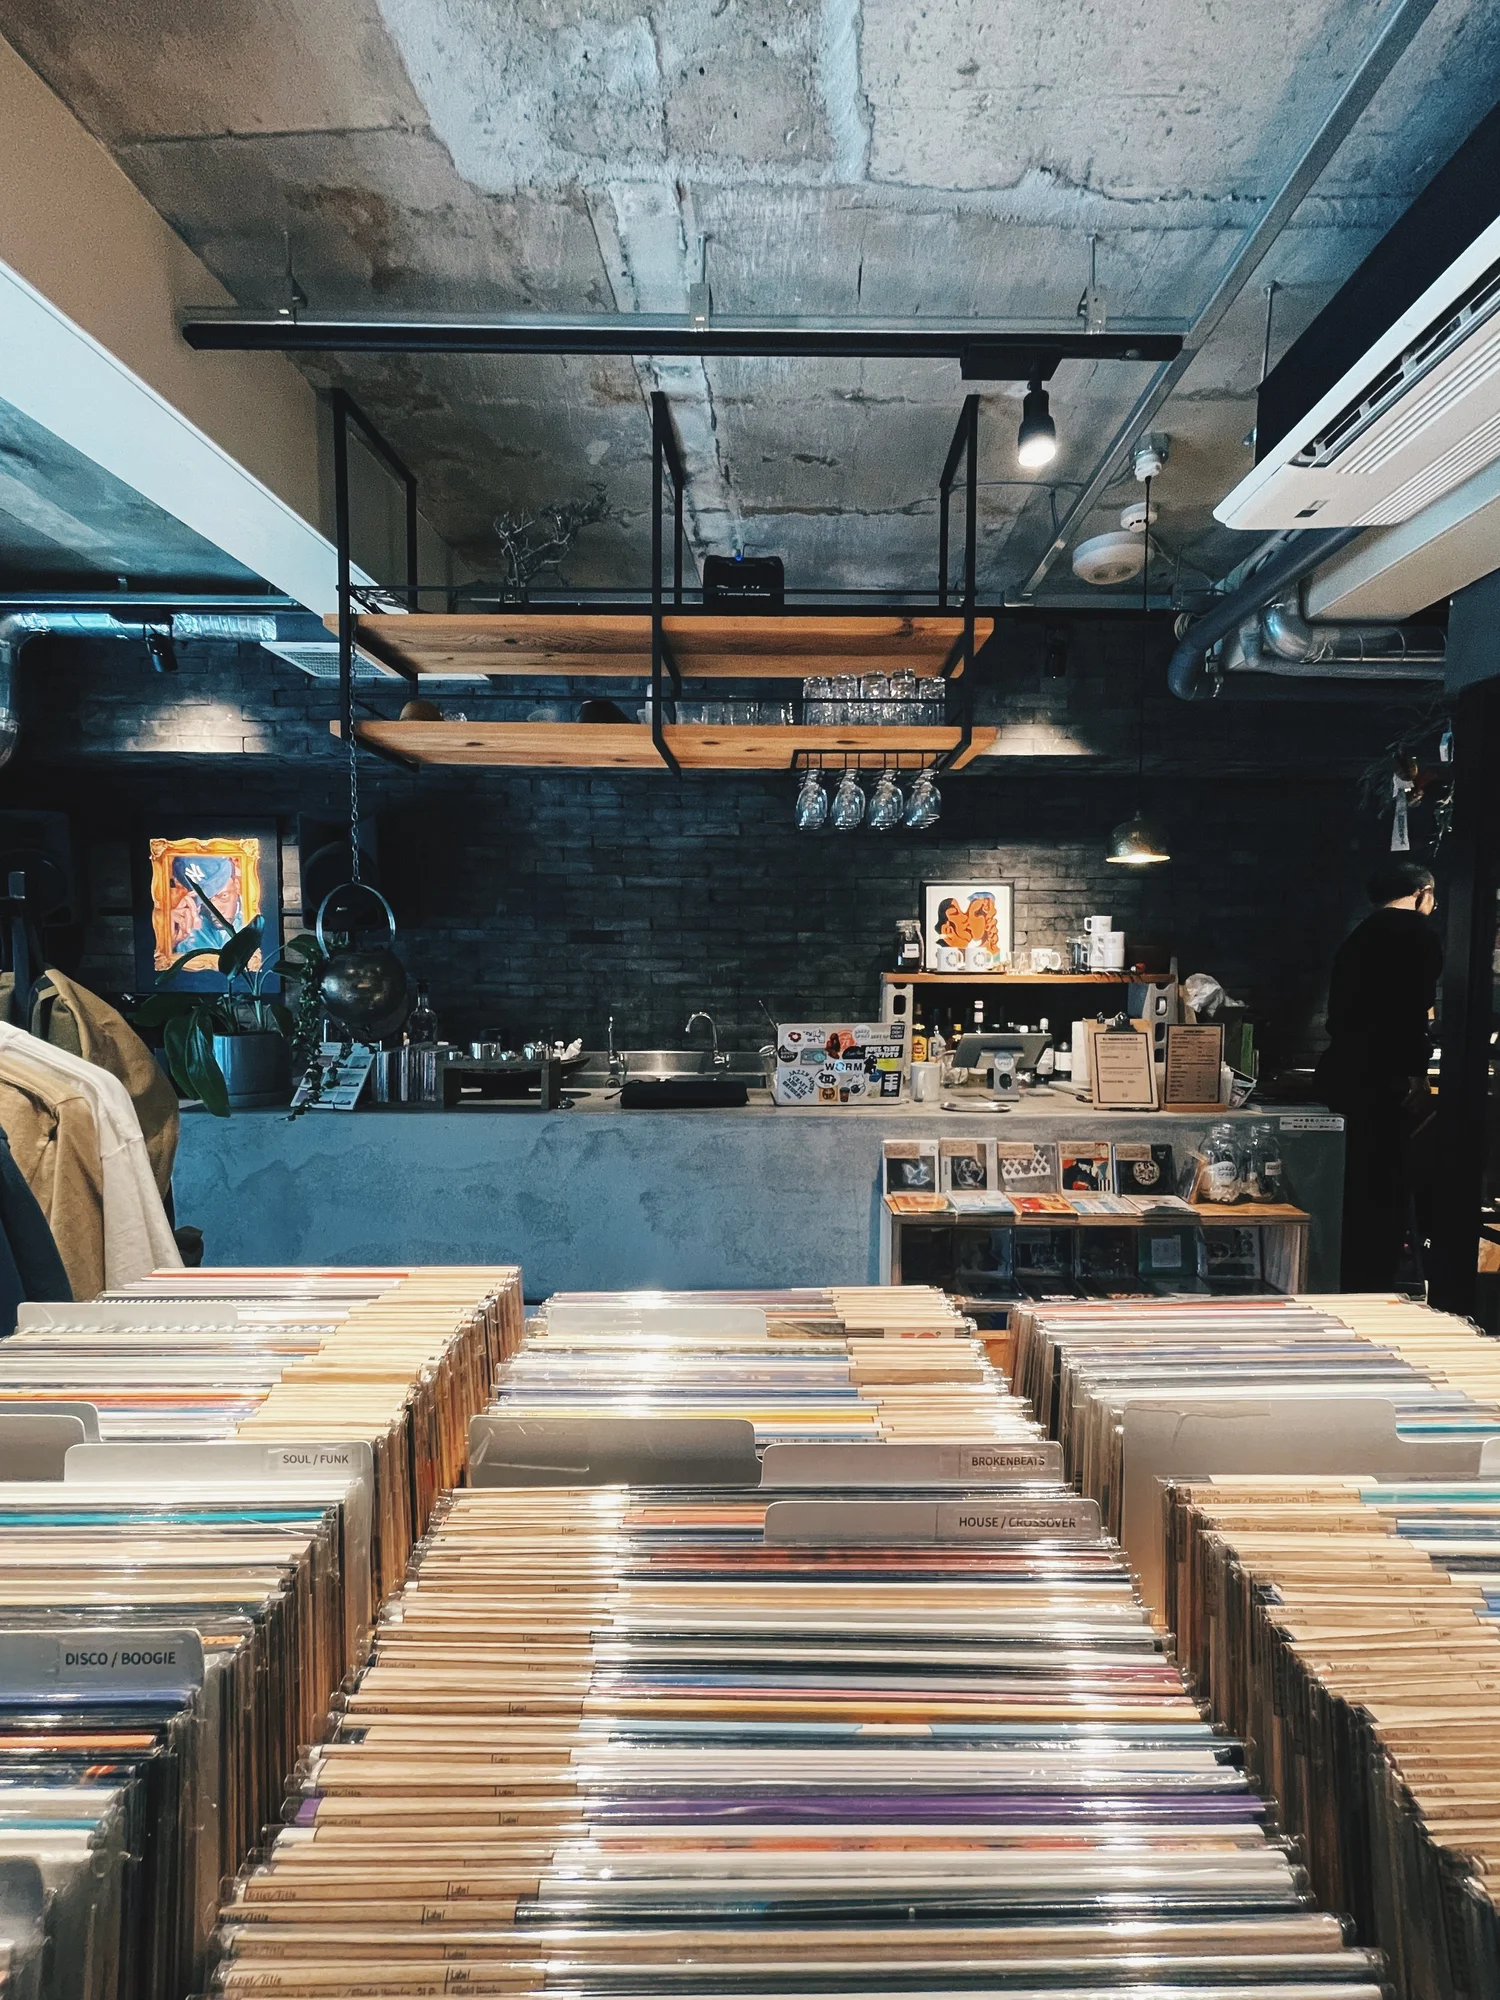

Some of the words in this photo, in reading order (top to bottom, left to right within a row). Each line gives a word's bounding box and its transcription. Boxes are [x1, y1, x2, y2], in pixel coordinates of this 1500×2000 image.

[826, 1062, 862, 1071] WORM
[283, 1454, 310, 1466] SOUL
[312, 1455, 318, 1467] /
[320, 1454, 349, 1465] FUNK
[972, 1457, 1045, 1467] BROKENBEATS
[959, 1516, 998, 1528] HOUSE
[1000, 1516, 1006, 1529] /
[1008, 1517, 1076, 1529] CROSSOVER
[65, 1653, 108, 1666] DISCO
[111, 1652, 118, 1668] /
[121, 1651, 176, 1665] BOOGIE
[451, 1884, 470, 1895] Label
[426, 1908, 446, 1919] Label
[451, 1969, 471, 1980] Label
